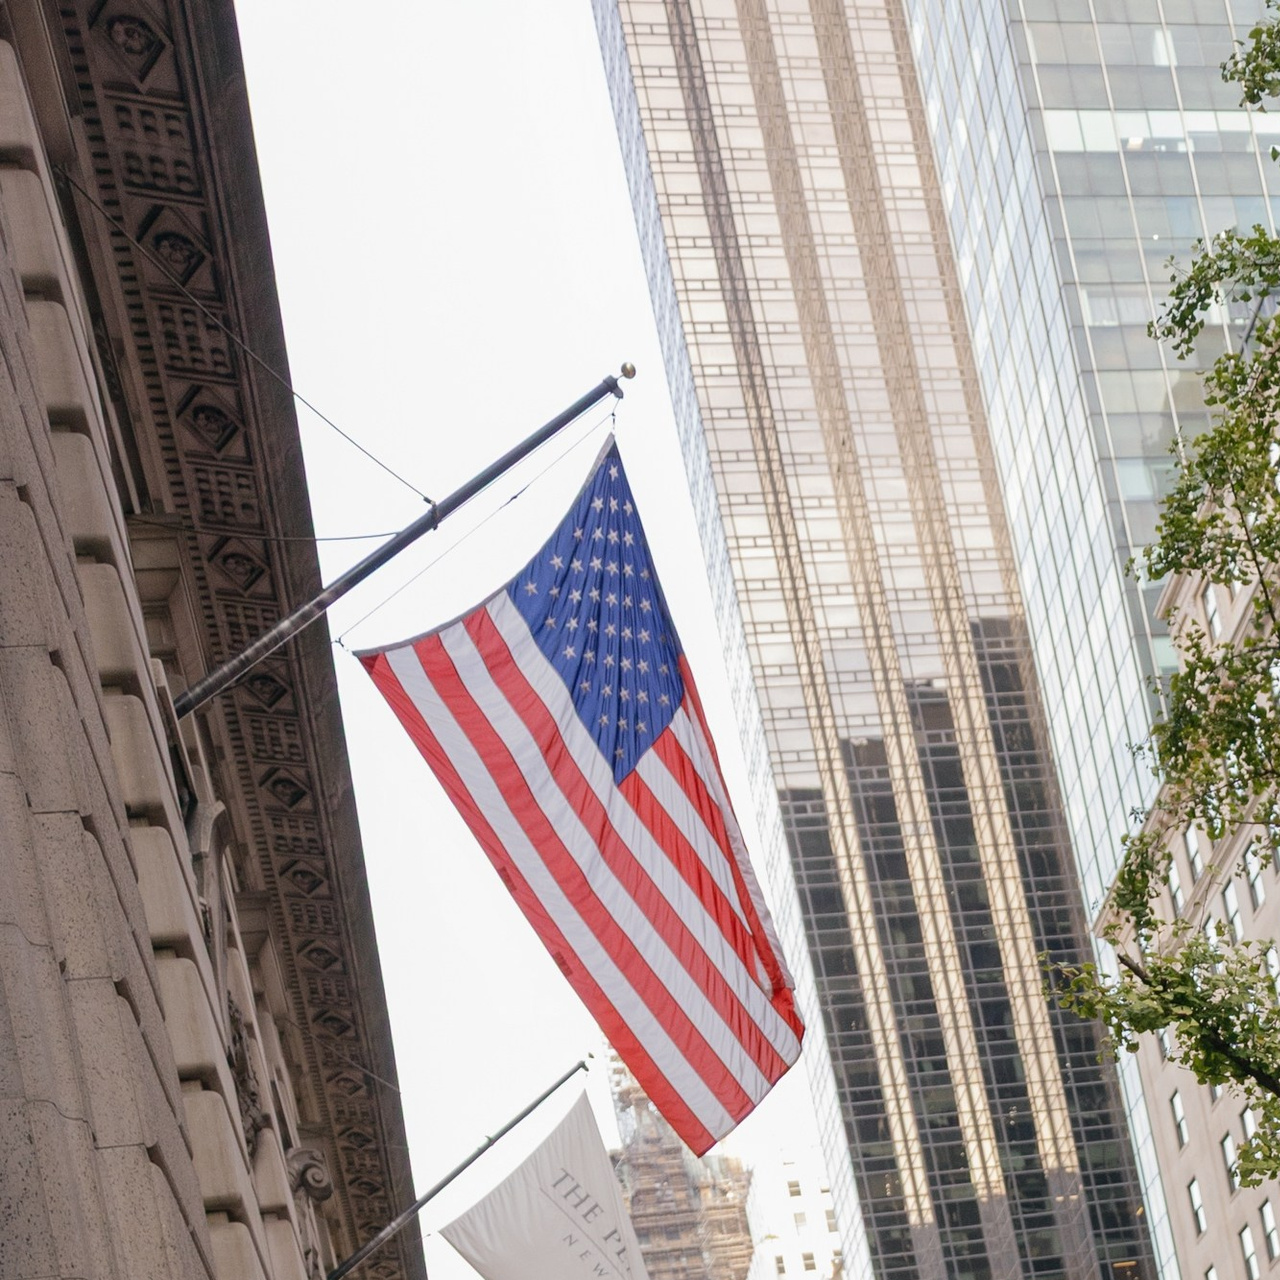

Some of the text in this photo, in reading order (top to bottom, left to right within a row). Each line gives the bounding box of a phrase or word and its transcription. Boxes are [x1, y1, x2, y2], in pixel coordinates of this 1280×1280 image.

[552, 1168, 631, 1272] THE PL
[562, 1234, 610, 1277] NEW
